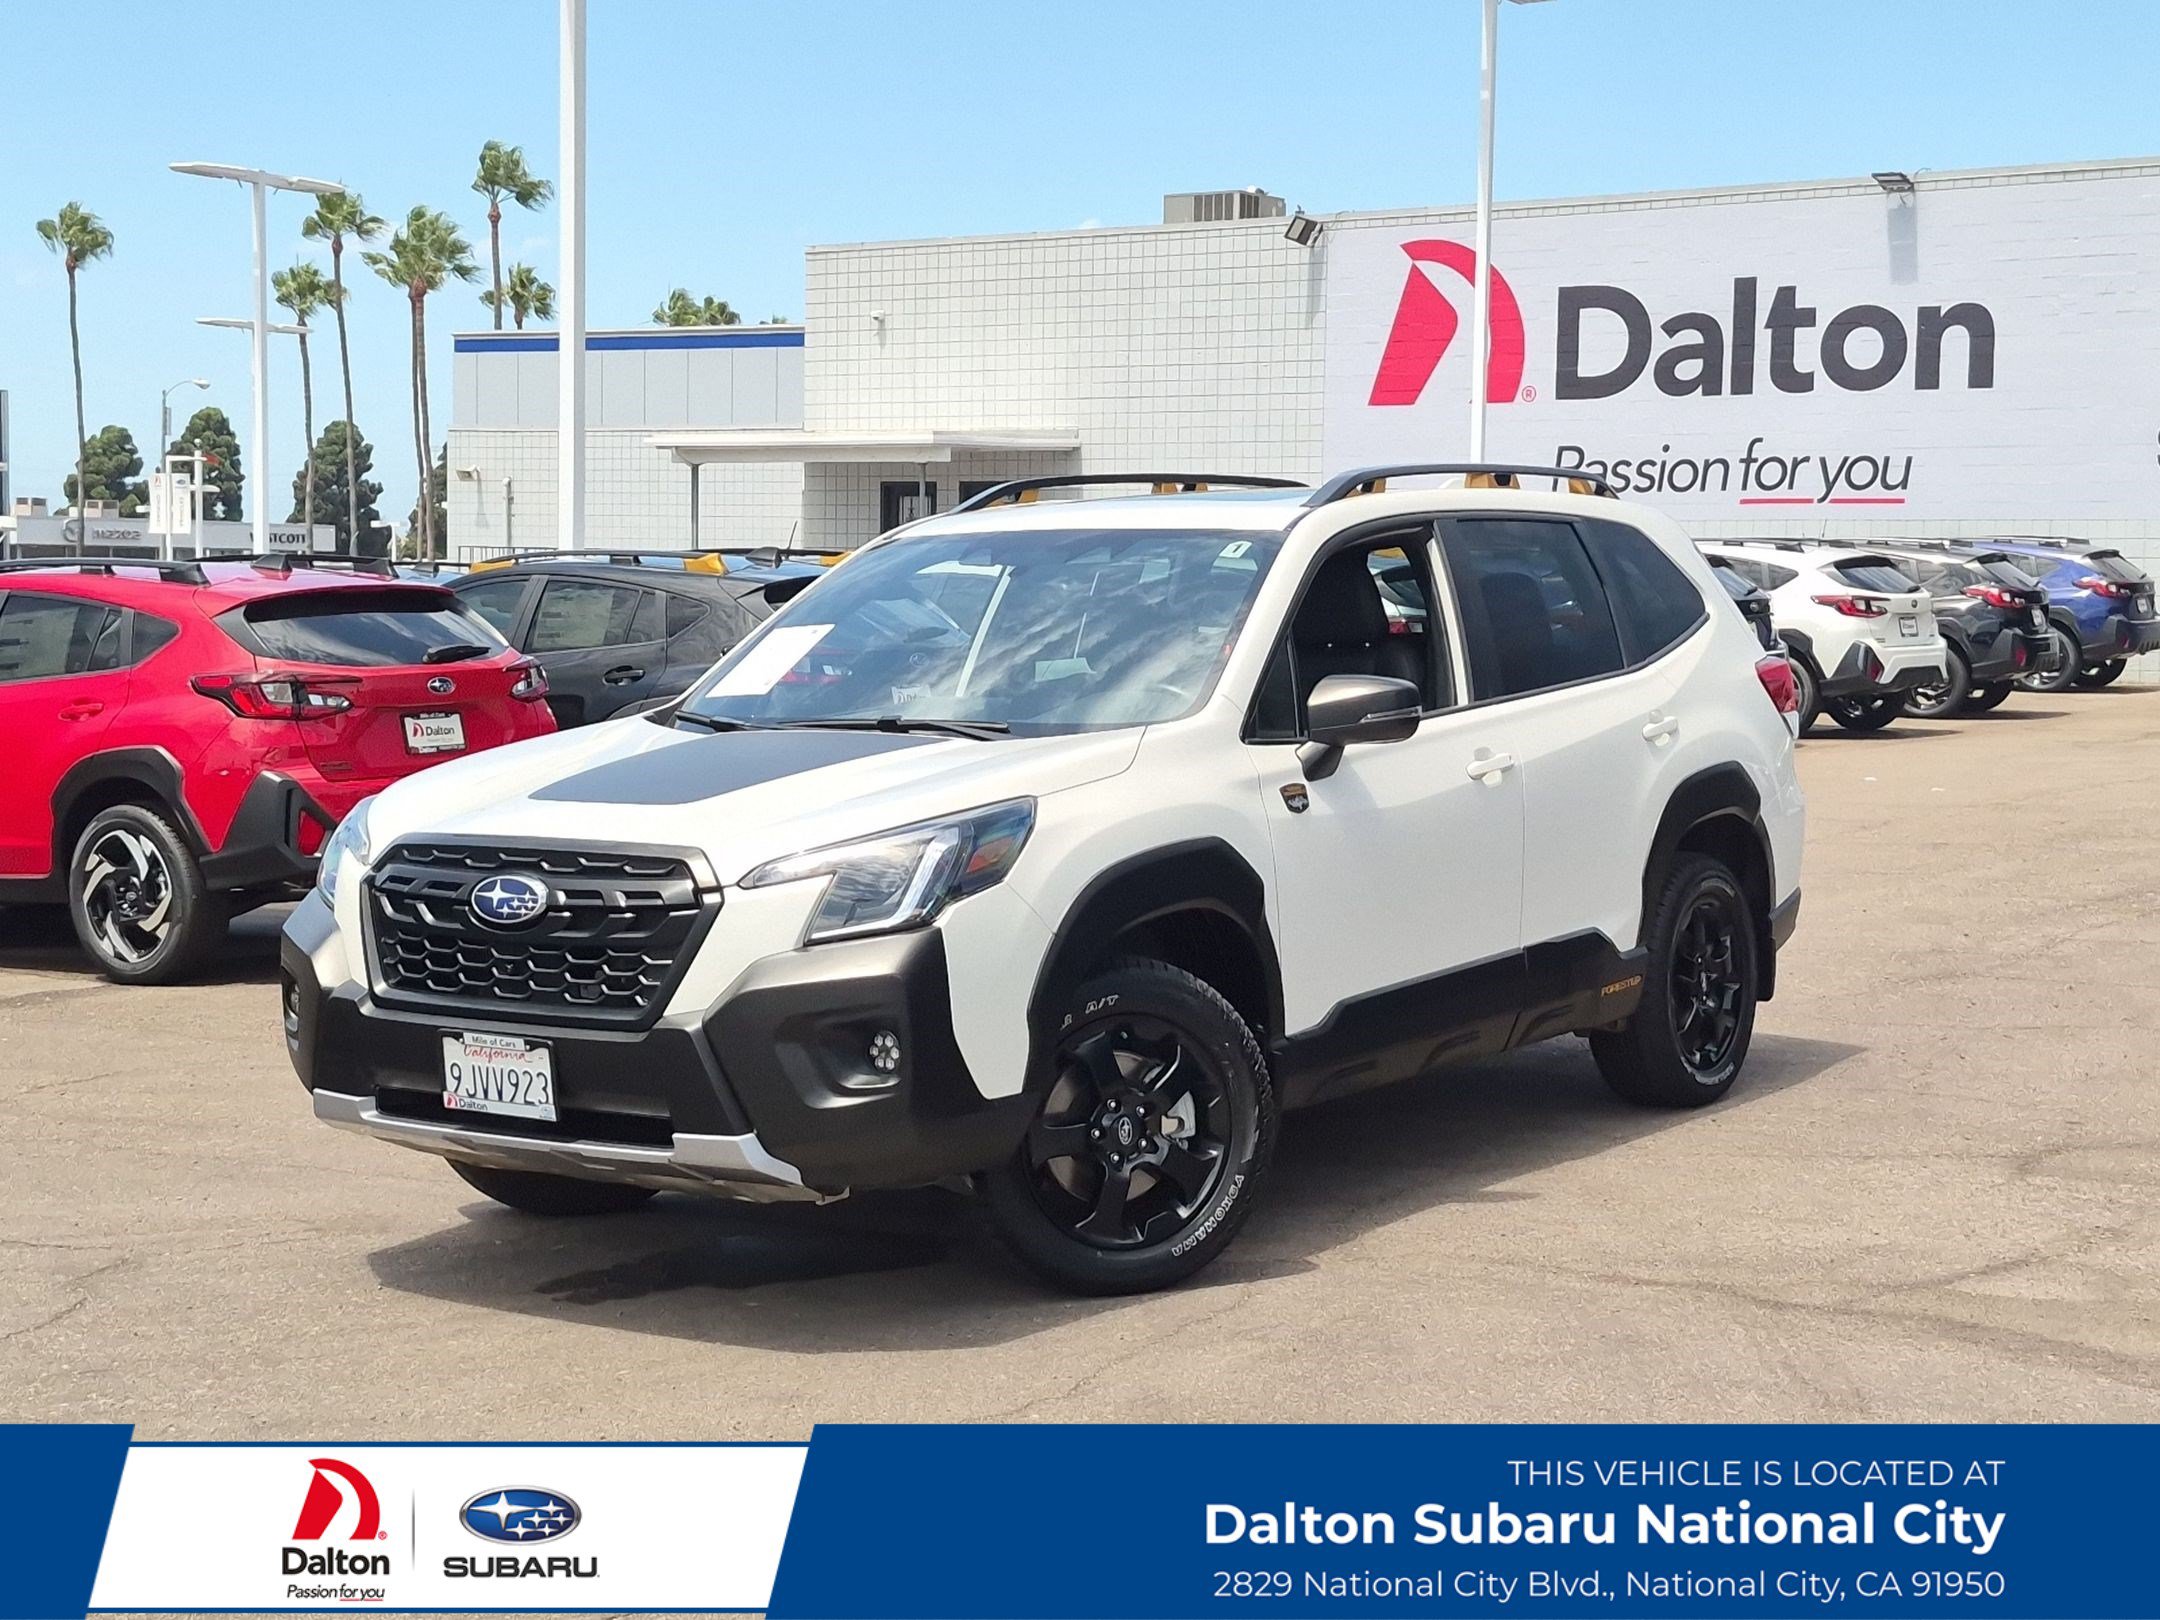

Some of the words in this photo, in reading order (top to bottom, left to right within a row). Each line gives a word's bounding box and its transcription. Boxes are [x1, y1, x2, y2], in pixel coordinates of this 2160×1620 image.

[1555, 276, 1995, 400] Dalton
[1551, 445, 1730, 493] Passion
[1738, 437, 1811, 491] for
[1817, 455, 1913, 504] you
[425, 725, 455, 736] Dalton
[489, 1037, 497, 1046] of
[499, 1038, 517, 1049] Cars
[450, 1062, 549, 1105] 9JVV923
[459, 1097, 489, 1111] Dalton
[1171, 1174, 1245, 1257] YOKOHAMA
